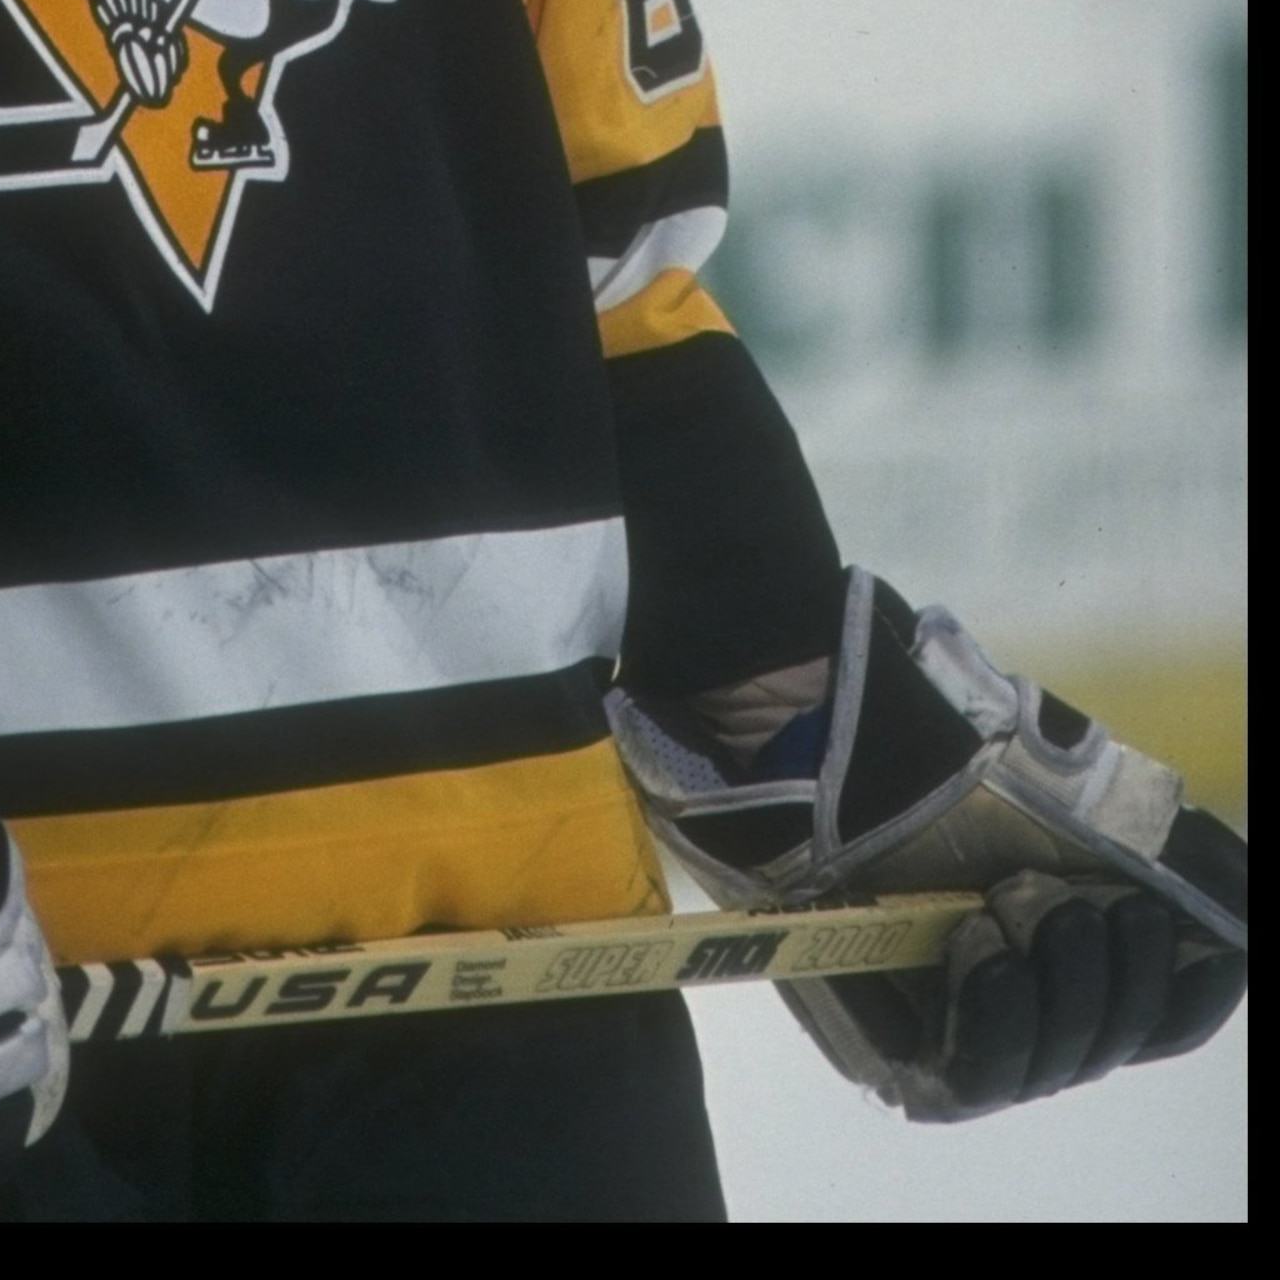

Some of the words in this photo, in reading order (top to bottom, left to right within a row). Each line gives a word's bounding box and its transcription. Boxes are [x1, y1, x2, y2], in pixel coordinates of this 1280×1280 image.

[537, 940, 675, 993] SUPER
[676, 930, 791, 981] STICK
[792, 920, 913, 972] 2000
[189, 961, 433, 1021] USA
